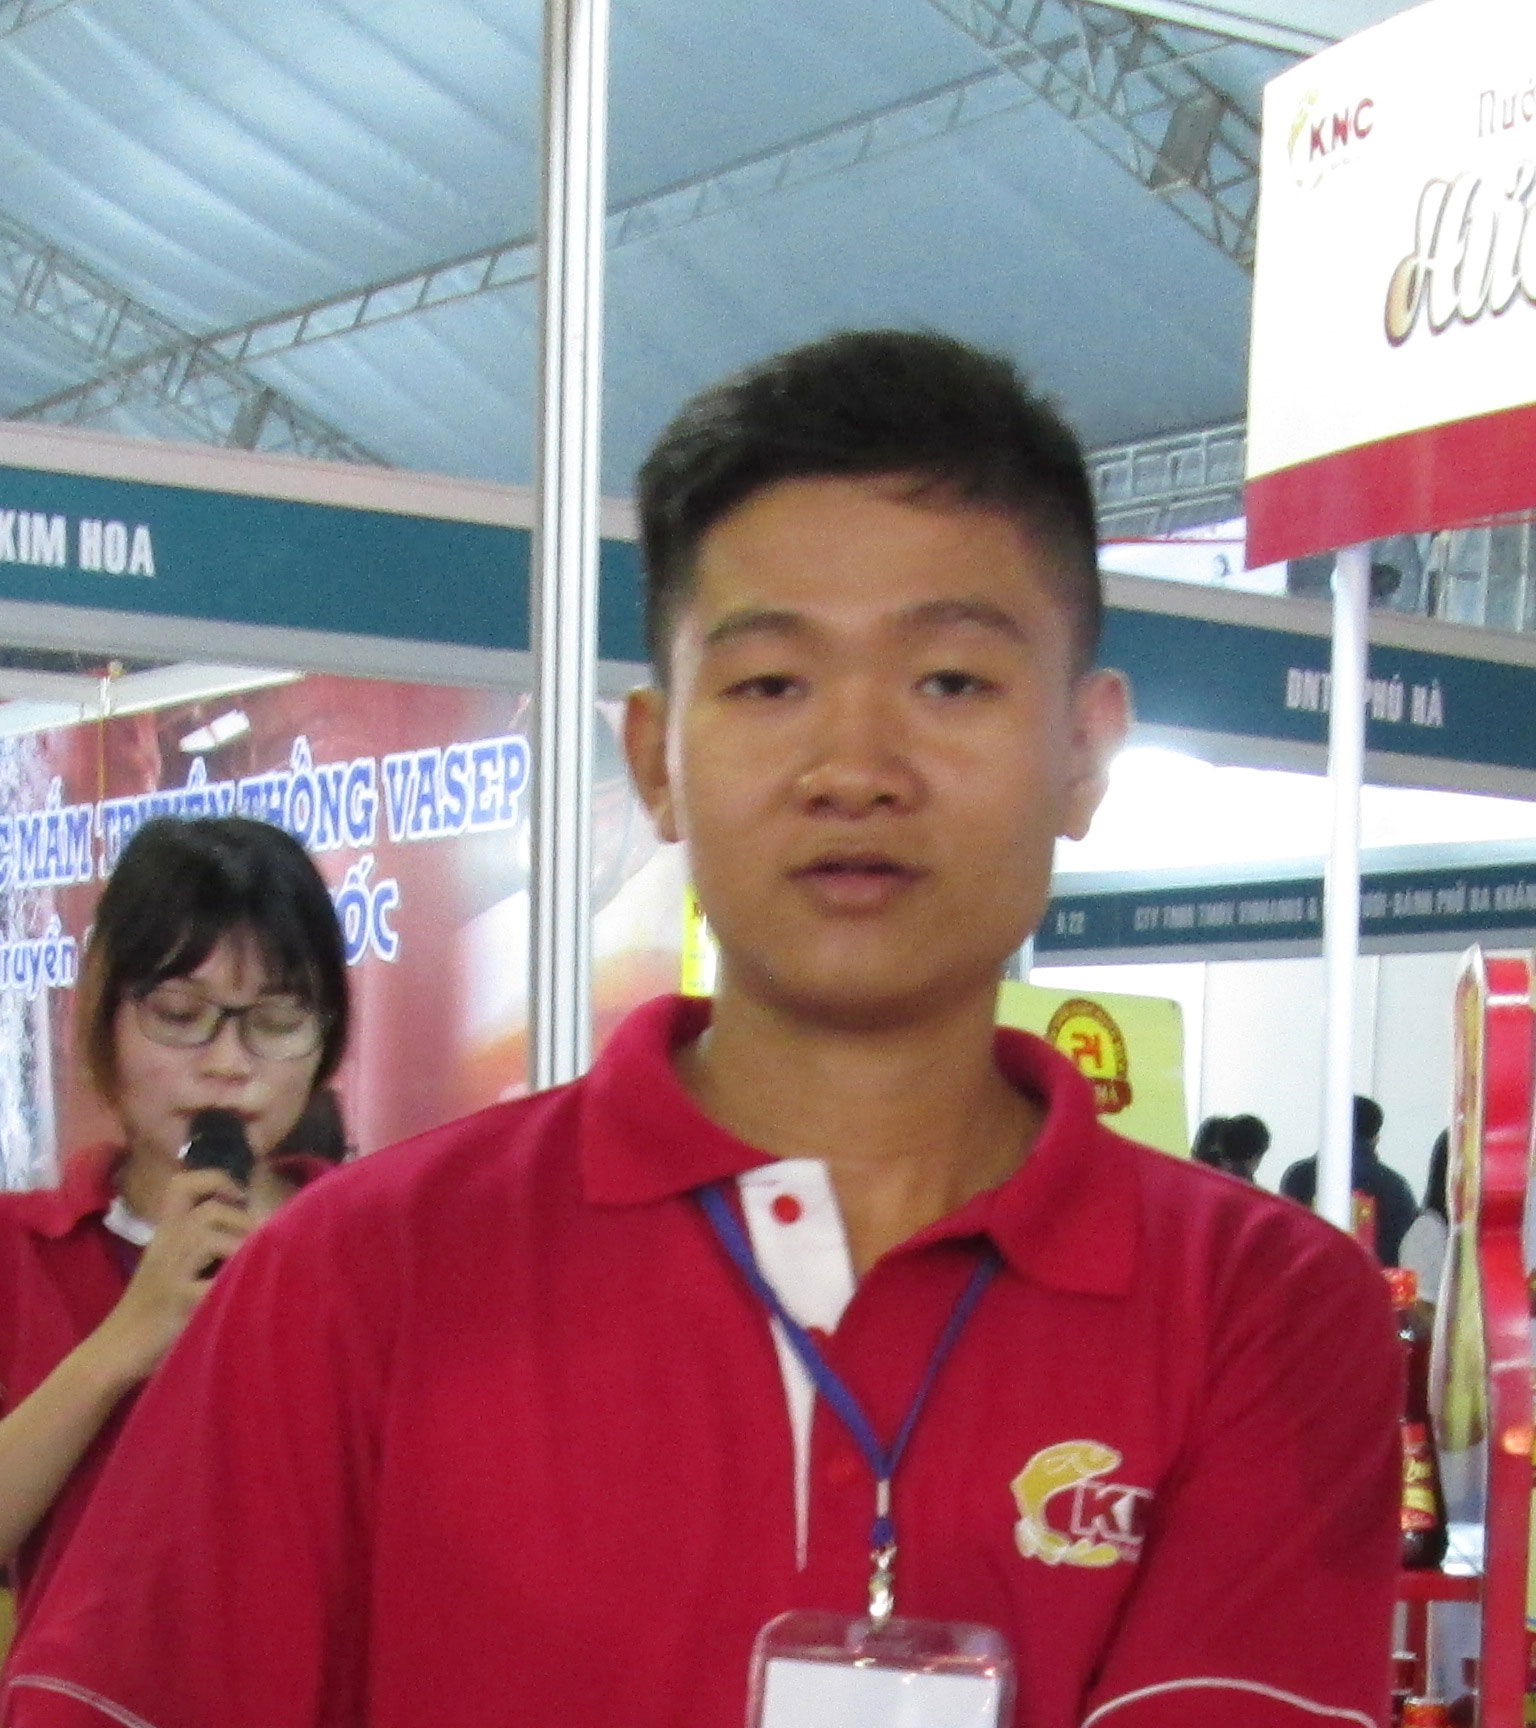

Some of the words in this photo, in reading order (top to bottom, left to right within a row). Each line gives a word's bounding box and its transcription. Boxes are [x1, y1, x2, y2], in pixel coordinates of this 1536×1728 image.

[1309, 96, 1375, 163] KNC
[77, 517, 157, 578] HOA
[1286, 667, 1334, 713] DNT
[382, 734, 531, 843] VASEP
[334, 853, 400, 966] ỐC
